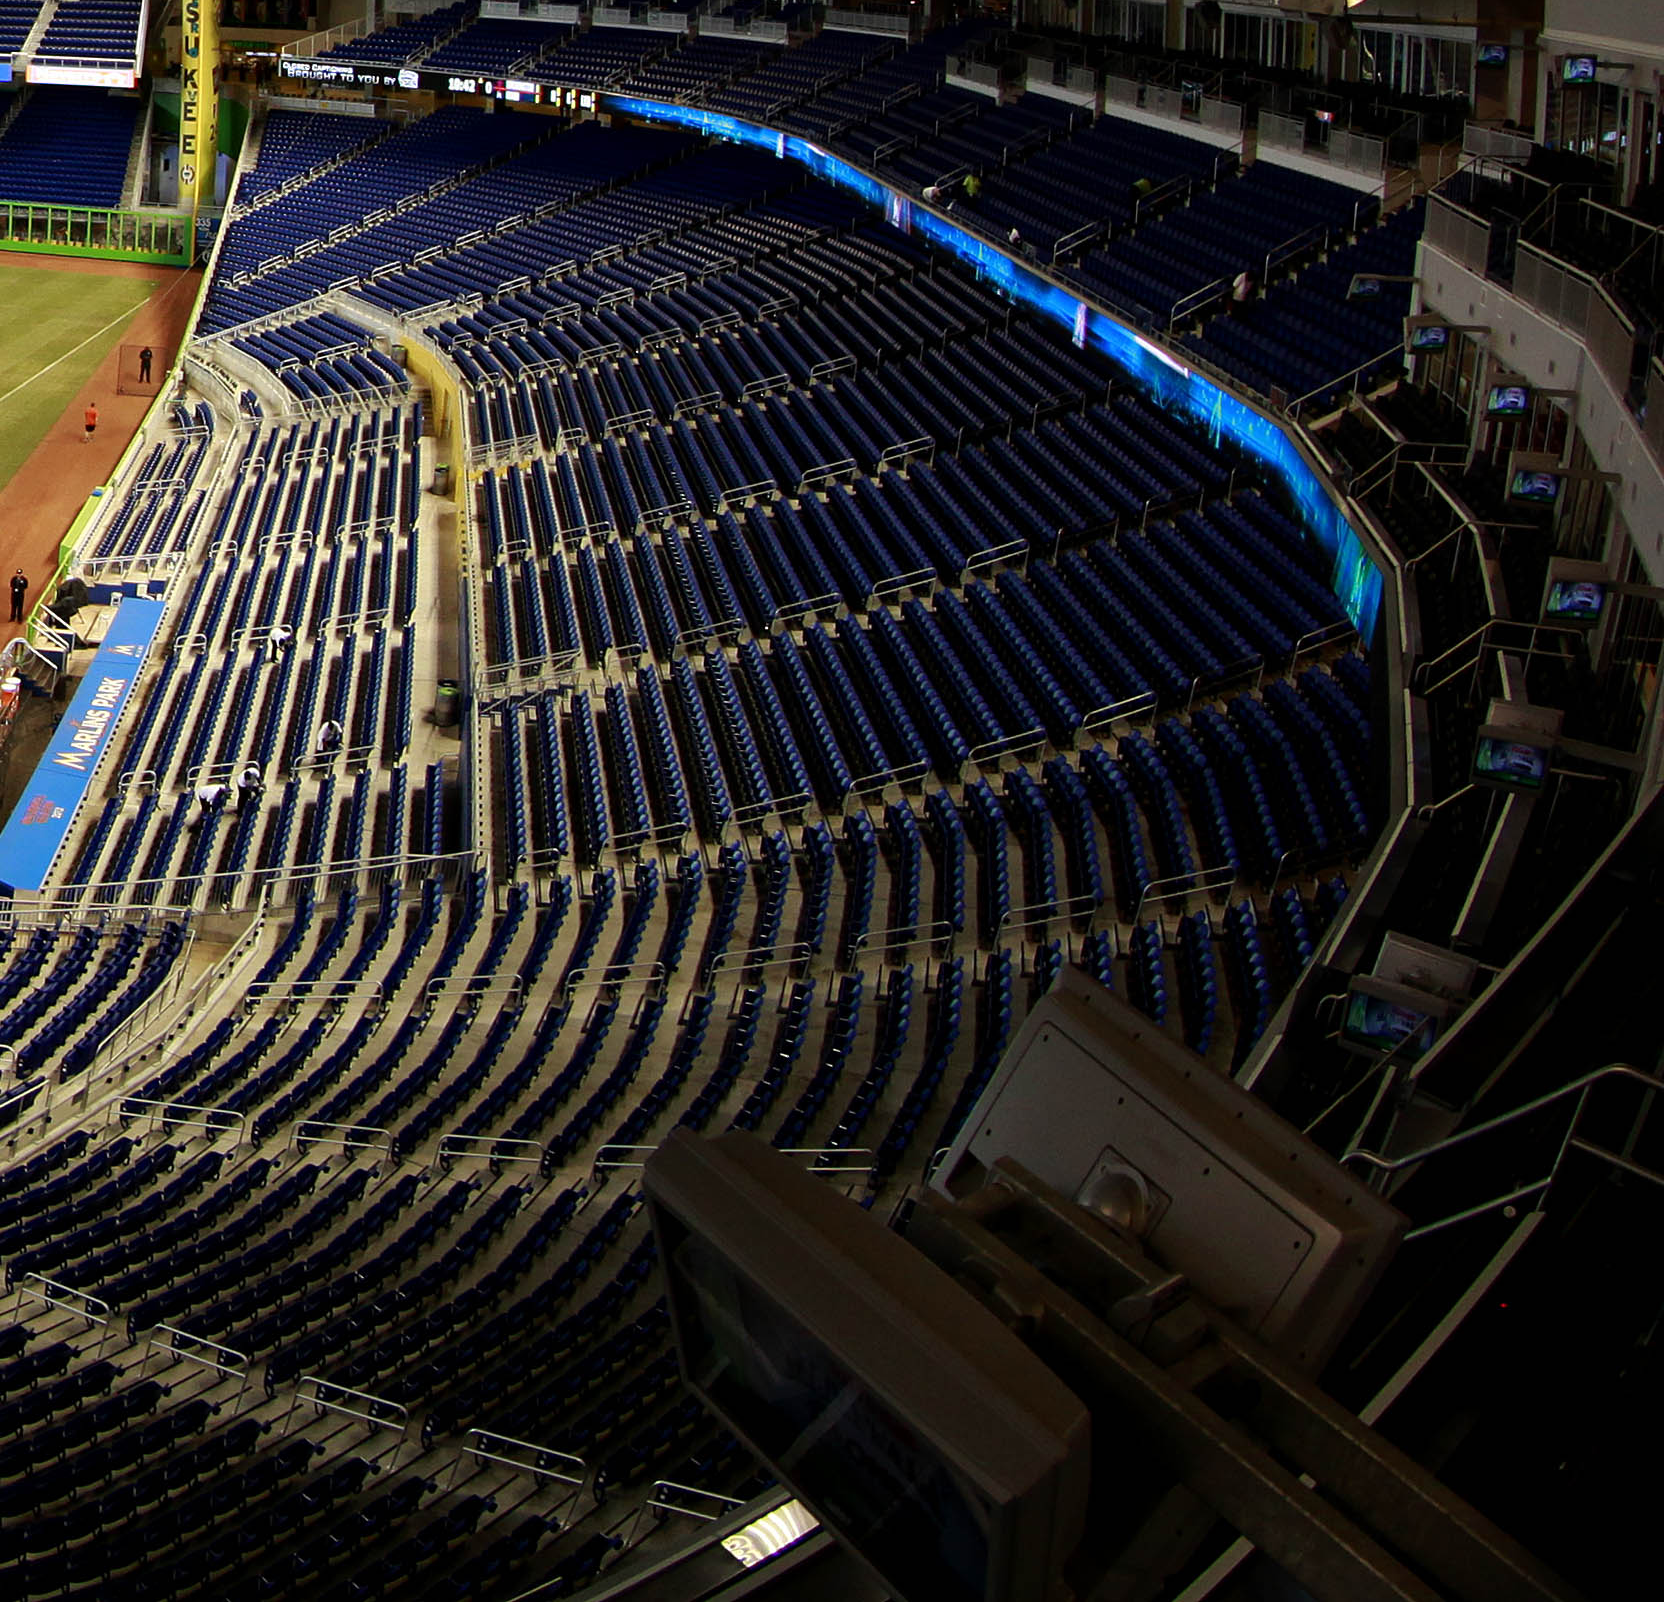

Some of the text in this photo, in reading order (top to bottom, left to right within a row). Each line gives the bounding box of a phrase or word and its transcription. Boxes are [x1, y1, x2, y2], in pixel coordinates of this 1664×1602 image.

[287, 68, 396, 86] BROUGHT TO YOU BY
[53, 677, 126, 771] MARLINS PARK
